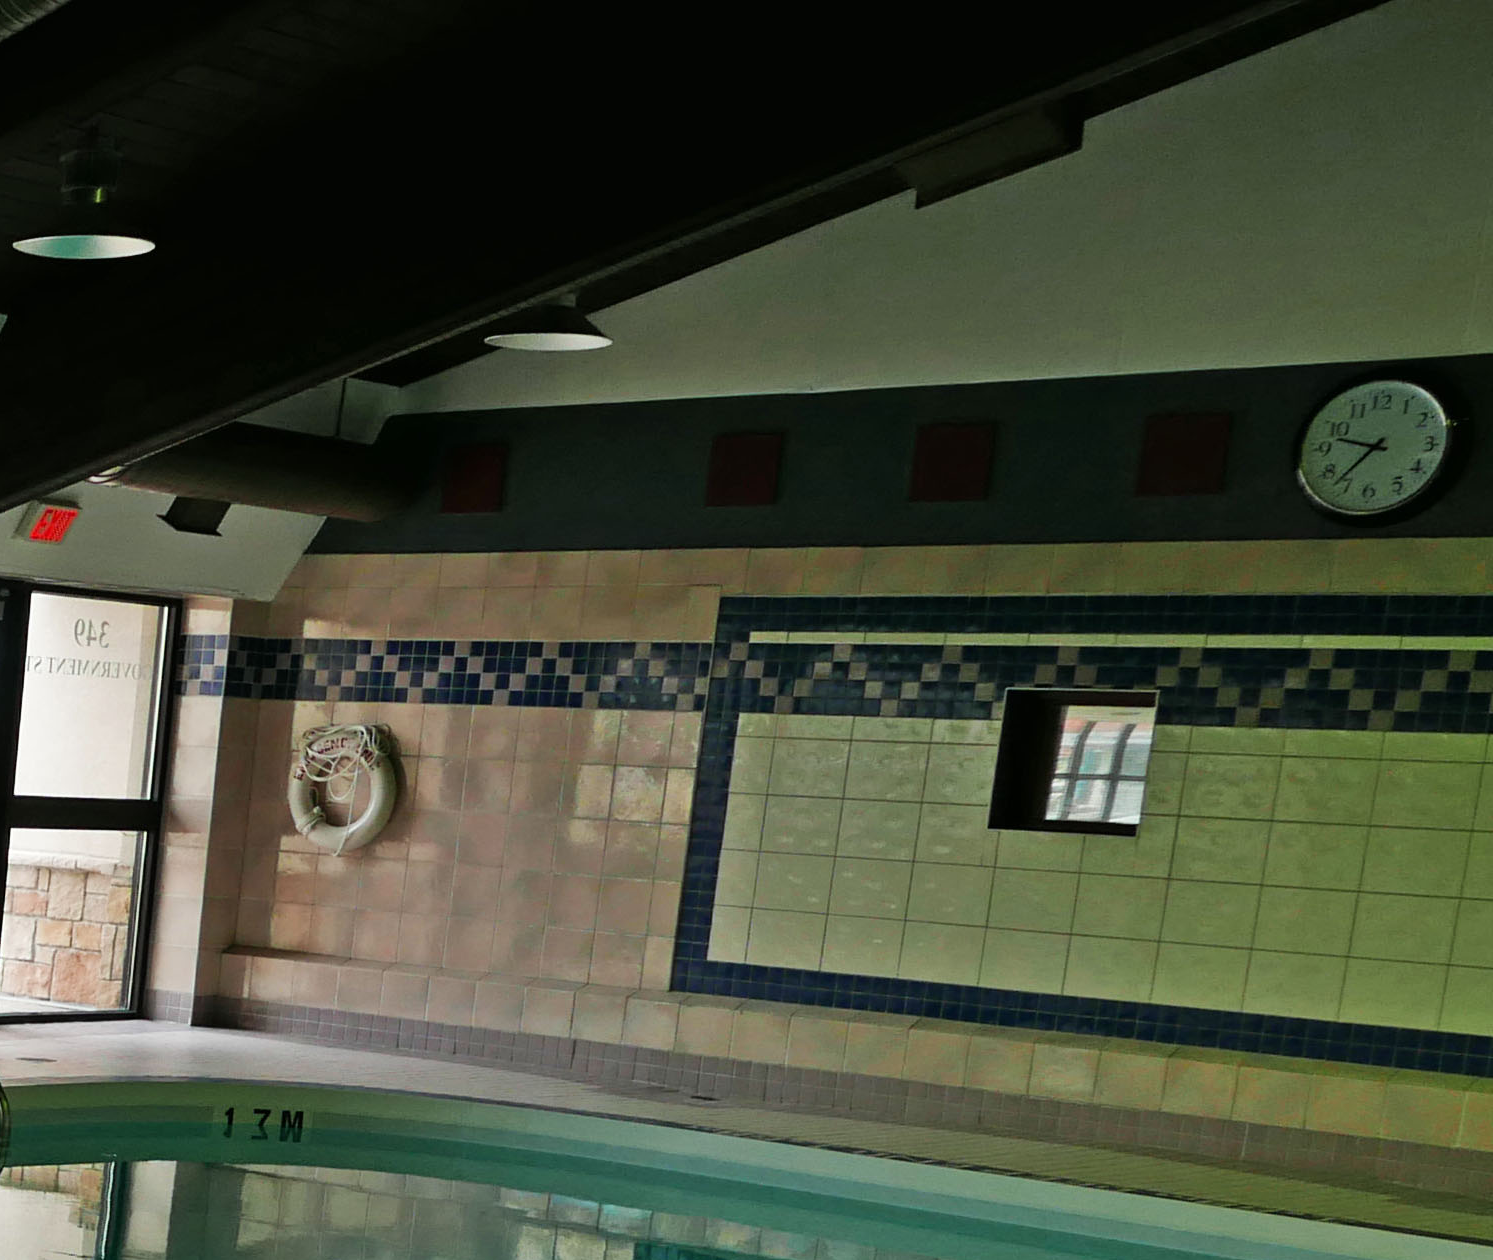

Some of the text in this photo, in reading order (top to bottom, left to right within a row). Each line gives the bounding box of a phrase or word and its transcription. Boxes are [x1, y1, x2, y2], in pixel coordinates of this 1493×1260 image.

[1349, 403, 1366, 419] 11
[1372, 394, 1393, 411] 12
[1403, 397, 1411, 415] 1
[1415, 412, 1429, 428] 2
[1329, 421, 1350, 437] 10
[1318, 441, 1332, 457] 9
[1423, 435, 1436, 452] 3
[1322, 463, 1336, 480] 8
[1409, 458, 1422, 474] 4
[1361, 482, 1376, 499] 6
[1391, 475, 1404, 493] 5
[28, 505, 79, 543] EXIT
